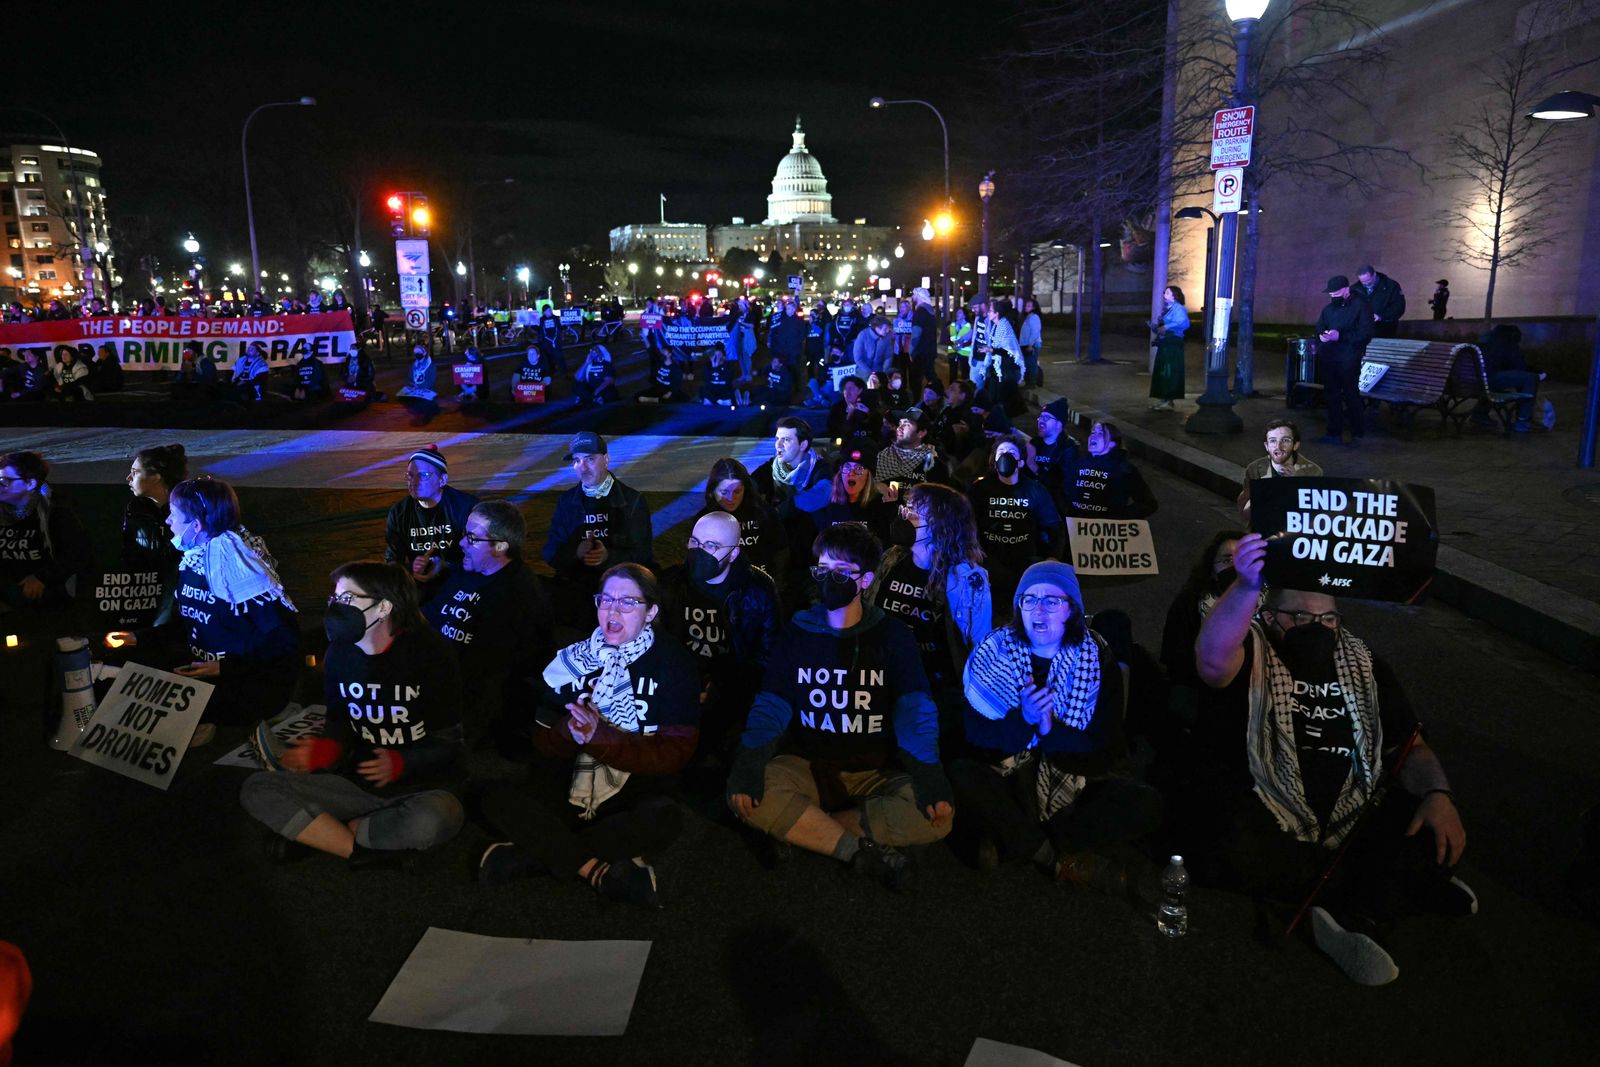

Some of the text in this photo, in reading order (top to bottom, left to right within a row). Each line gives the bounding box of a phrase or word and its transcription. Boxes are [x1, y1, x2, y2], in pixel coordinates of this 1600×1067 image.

[1221, 110, 1247, 122] SNOW
[1215, 118, 1251, 130] EMERGENCY
[1218, 126, 1248, 138] ROUTE
[1214, 136, 1249, 148] NO PARKING
[1220, 145, 1242, 155] DURING
[1213, 153, 1248, 163] EMERGENCY
[79, 319, 285, 336] THE PEOPLE DEMAND:
[1076, 479, 1107, 491] LEGACY
[989, 497, 1030, 508] BIDEN'S
[1297, 488, 1399, 517] END THE
[989, 510, 1028, 520] LEGACY
[409, 524, 453, 538] BIDEN'S
[1077, 522, 1140, 538] HOMES
[1285, 511, 1409, 544] BLOCKADE
[410, 539, 455, 552] LEGACY
[1092, 538, 1129, 553] NOT
[1291, 537, 1395, 568] ON GAZA
[1077, 553, 1152, 569] DRONES
[103, 571, 159, 586] END THE
[1331, 577, 1353, 588] AFSC
[95, 584, 163, 600] BLOCKADE
[181, 584, 217, 605] BIDEN'S
[99, 597, 158, 612] ON GAZA
[797, 667, 884, 687] NOT IN
[120, 672, 196, 712] HOMES
[809, 687, 872, 711] OUR
[118, 702, 169, 736] NOT
[347, 702, 411, 724] OUR
[800, 709, 884, 735] NAME
[80, 723, 177, 776] DRONES
